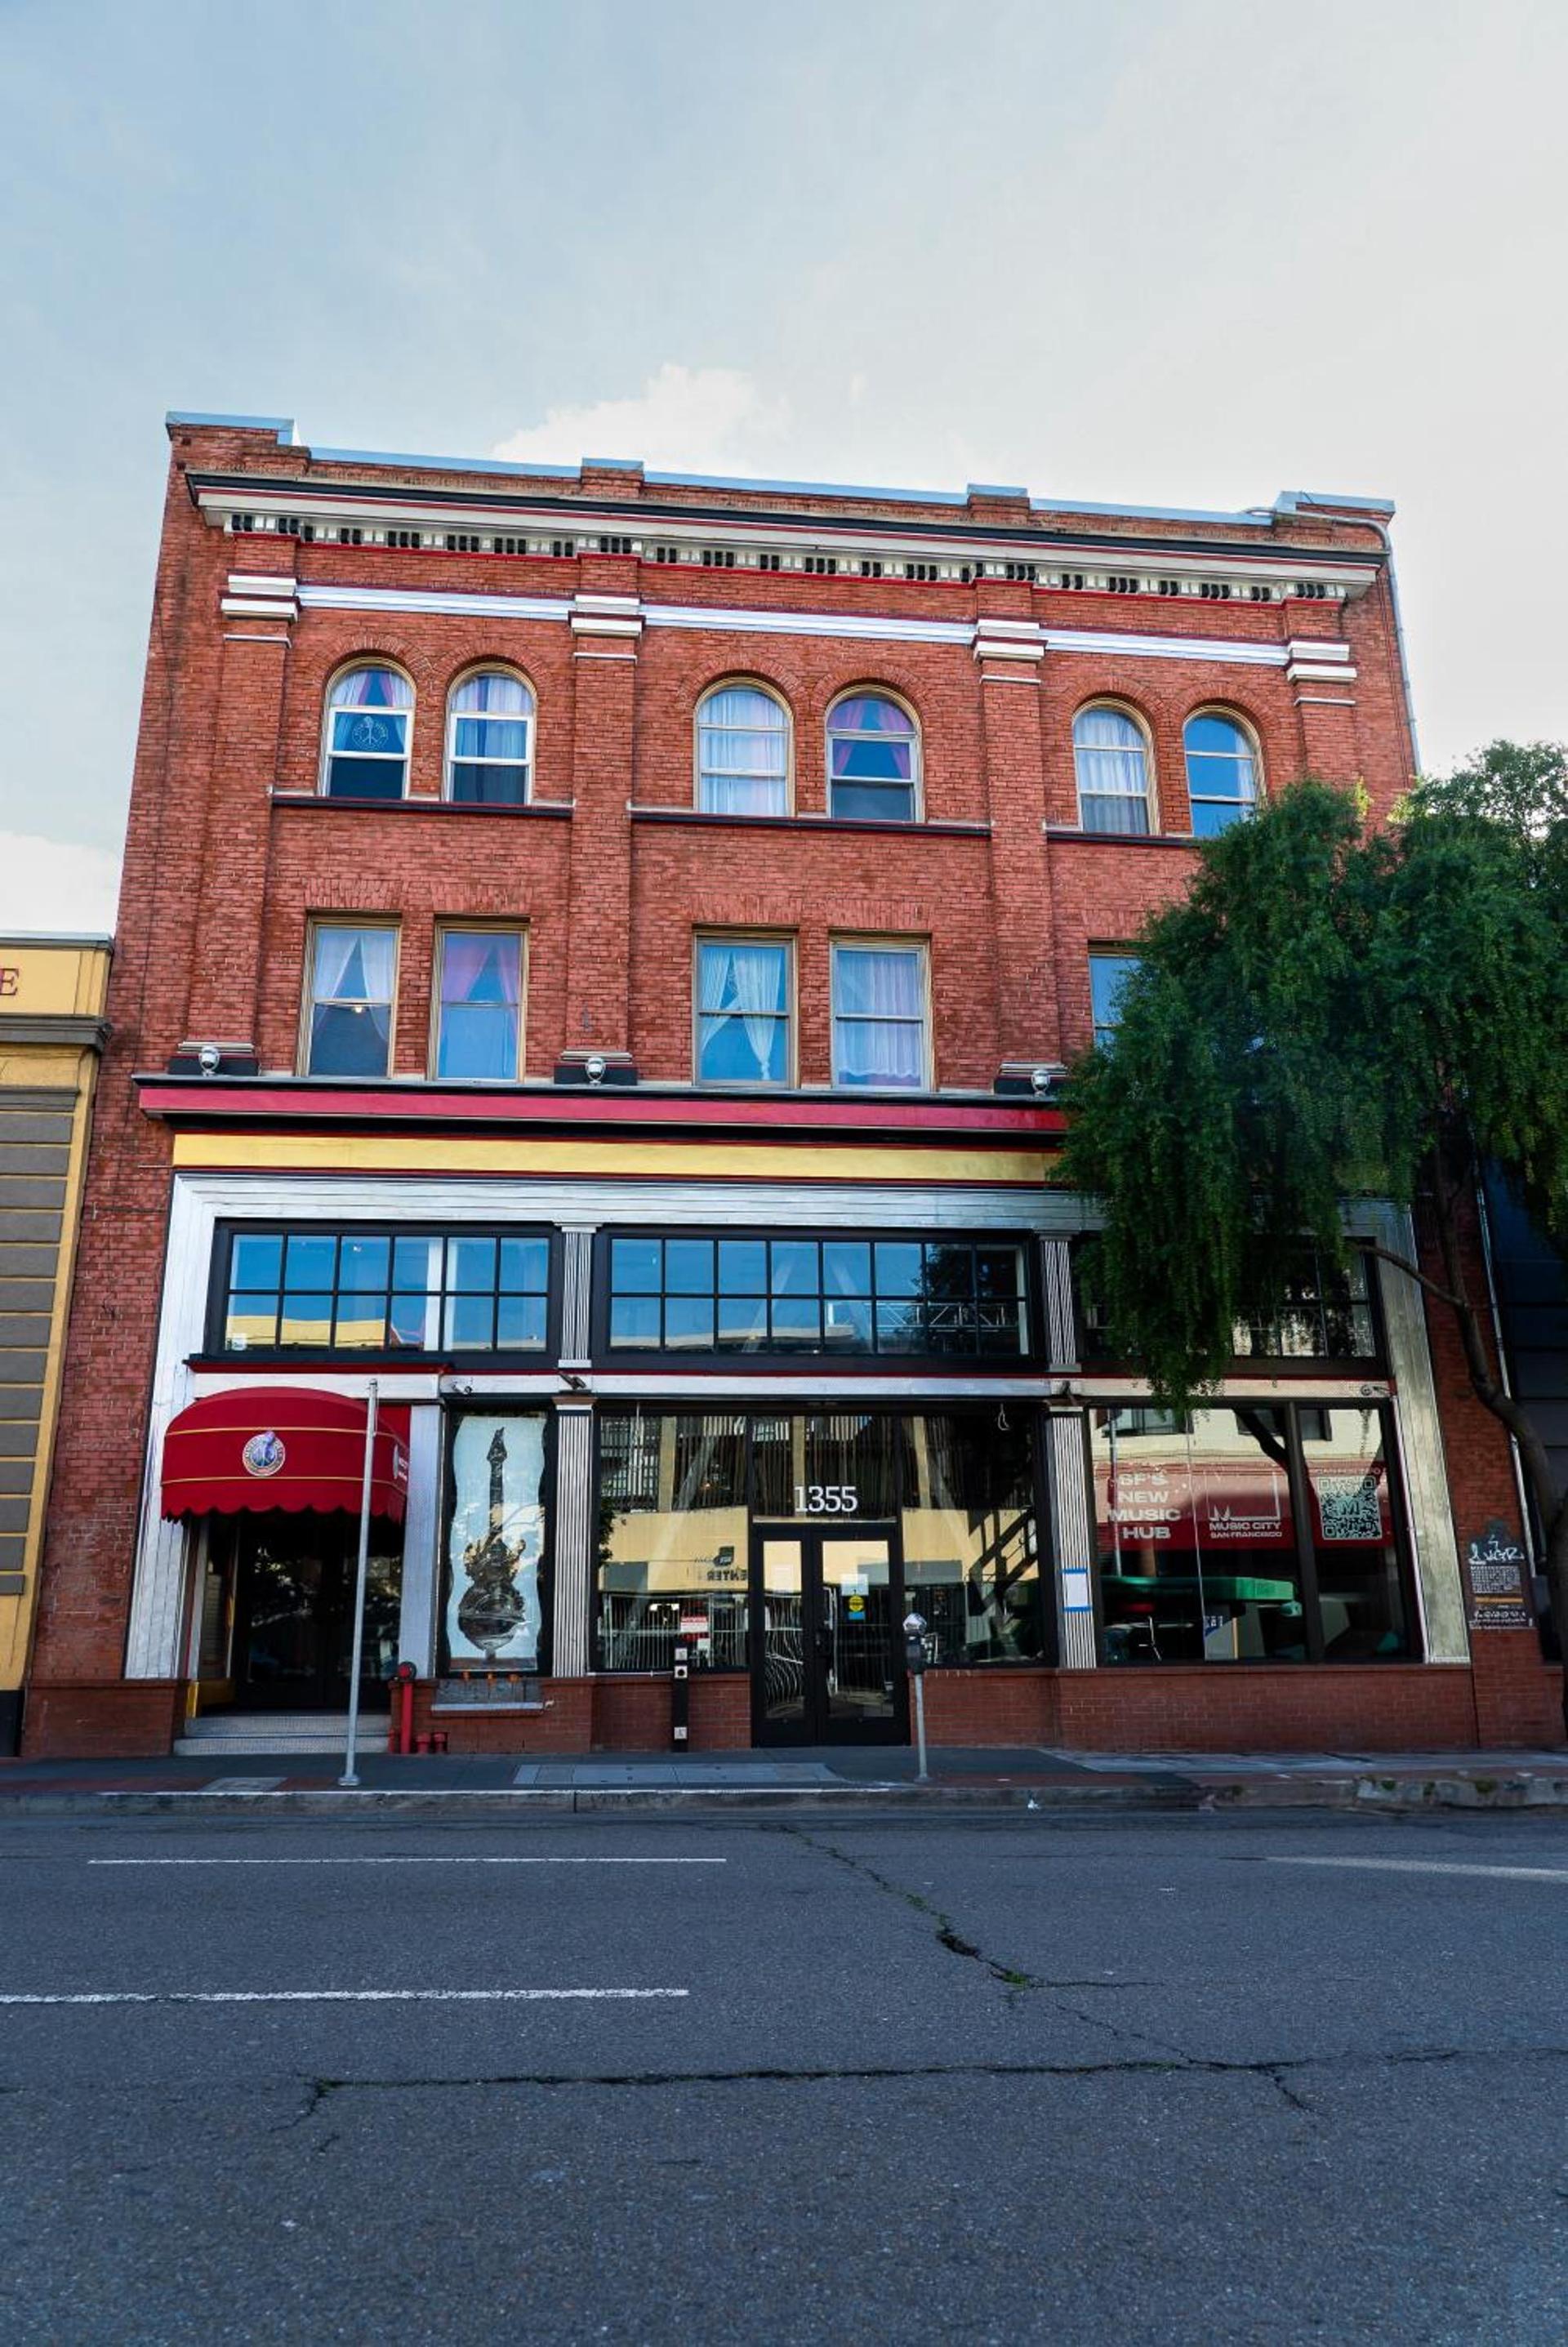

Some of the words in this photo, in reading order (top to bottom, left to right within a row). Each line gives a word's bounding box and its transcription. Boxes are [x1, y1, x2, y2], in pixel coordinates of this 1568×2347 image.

[794, 1485, 858, 1512] 1355
[1118, 1491, 1169, 1503] NEW
[1109, 1508, 1182, 1521] MUSIC
[1122, 1526, 1171, 1539] HUB
[1209, 1521, 1250, 1531] MUSIC
[1252, 1521, 1281, 1530] CITY
